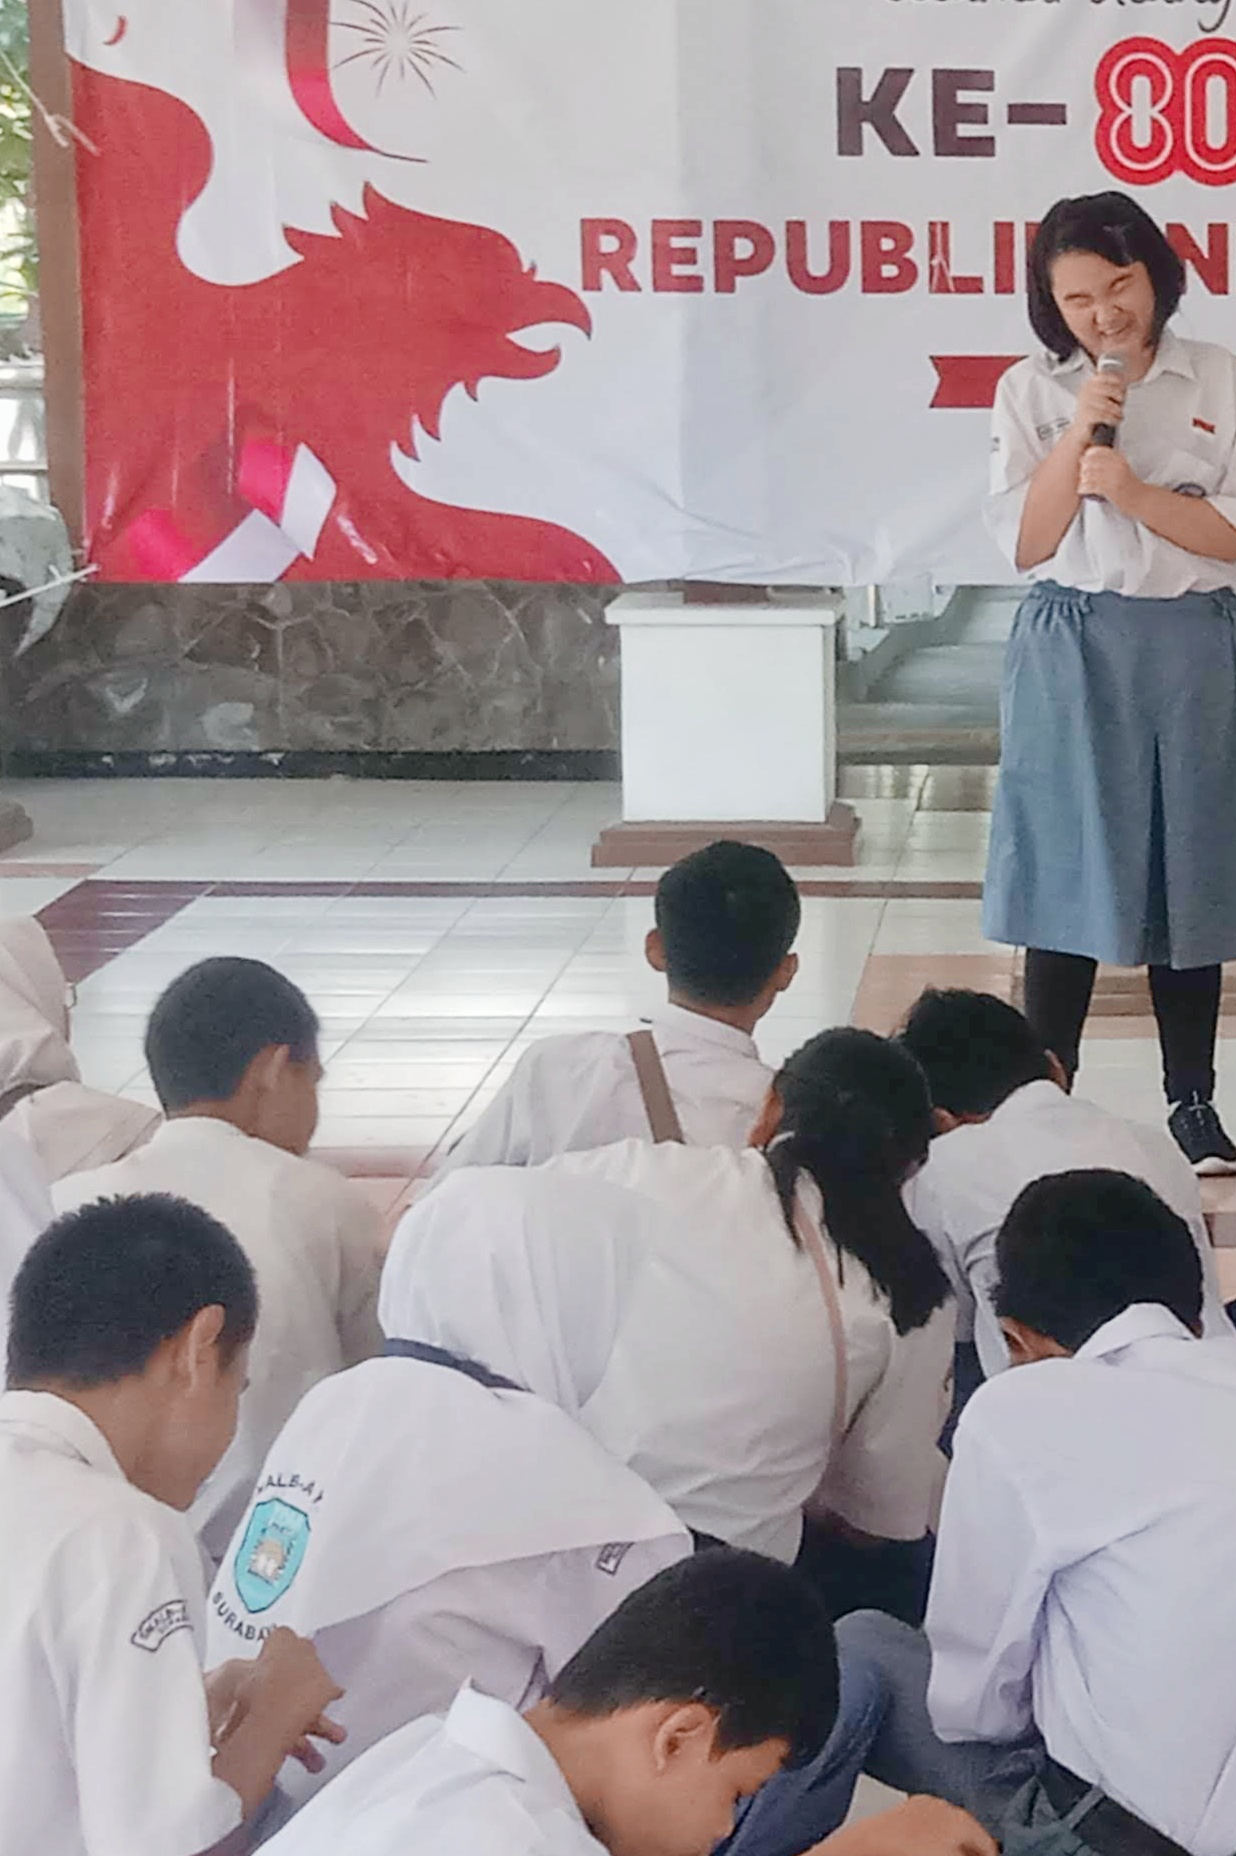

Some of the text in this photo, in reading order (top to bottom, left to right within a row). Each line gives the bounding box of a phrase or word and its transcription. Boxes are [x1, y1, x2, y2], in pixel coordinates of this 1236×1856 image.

[836, 66, 1068, 157] KE-
[580, 218, 1041, 295] REPUBLI
[212, 1591, 277, 1642] SURABA
